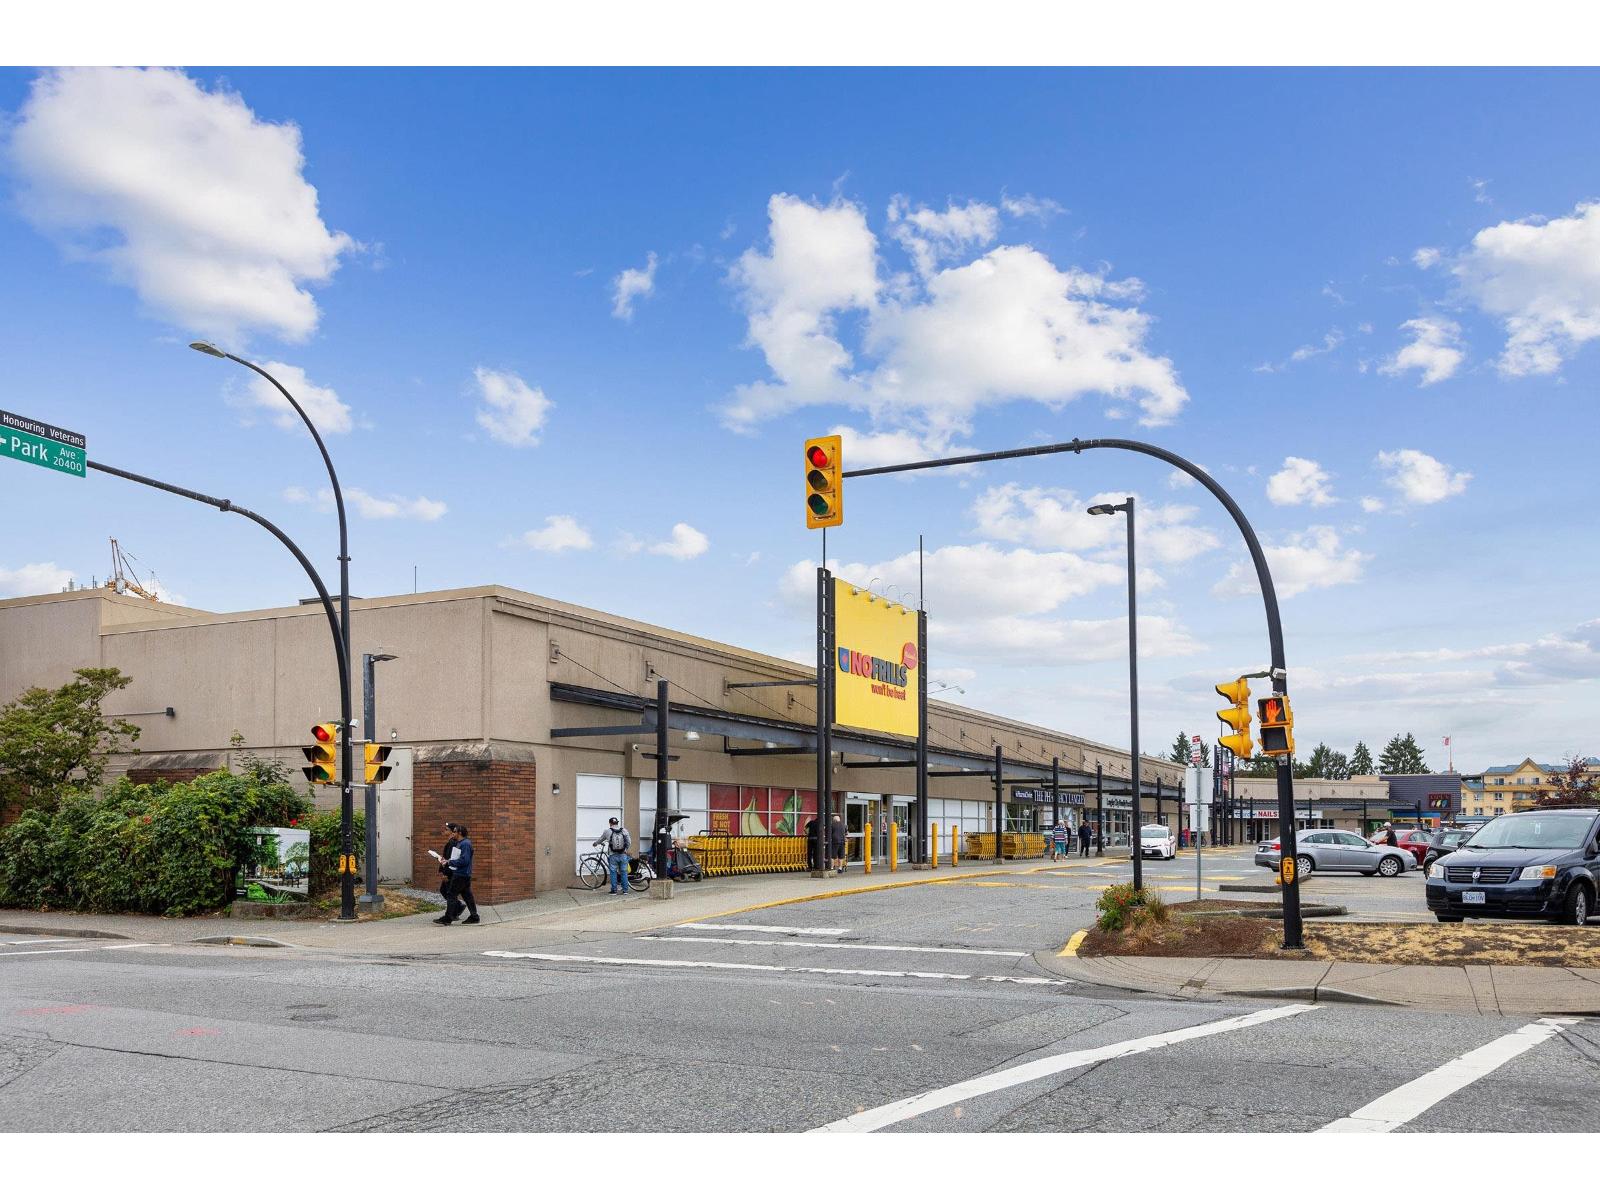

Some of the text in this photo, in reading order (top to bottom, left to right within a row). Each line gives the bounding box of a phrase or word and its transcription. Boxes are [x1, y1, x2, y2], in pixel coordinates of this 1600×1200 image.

[3, 414, 84, 446] Honouring Veterans
[11, 436, 48, 461] Park
[60, 447, 76, 460] Ave
[53, 456, 82, 472] 20400
